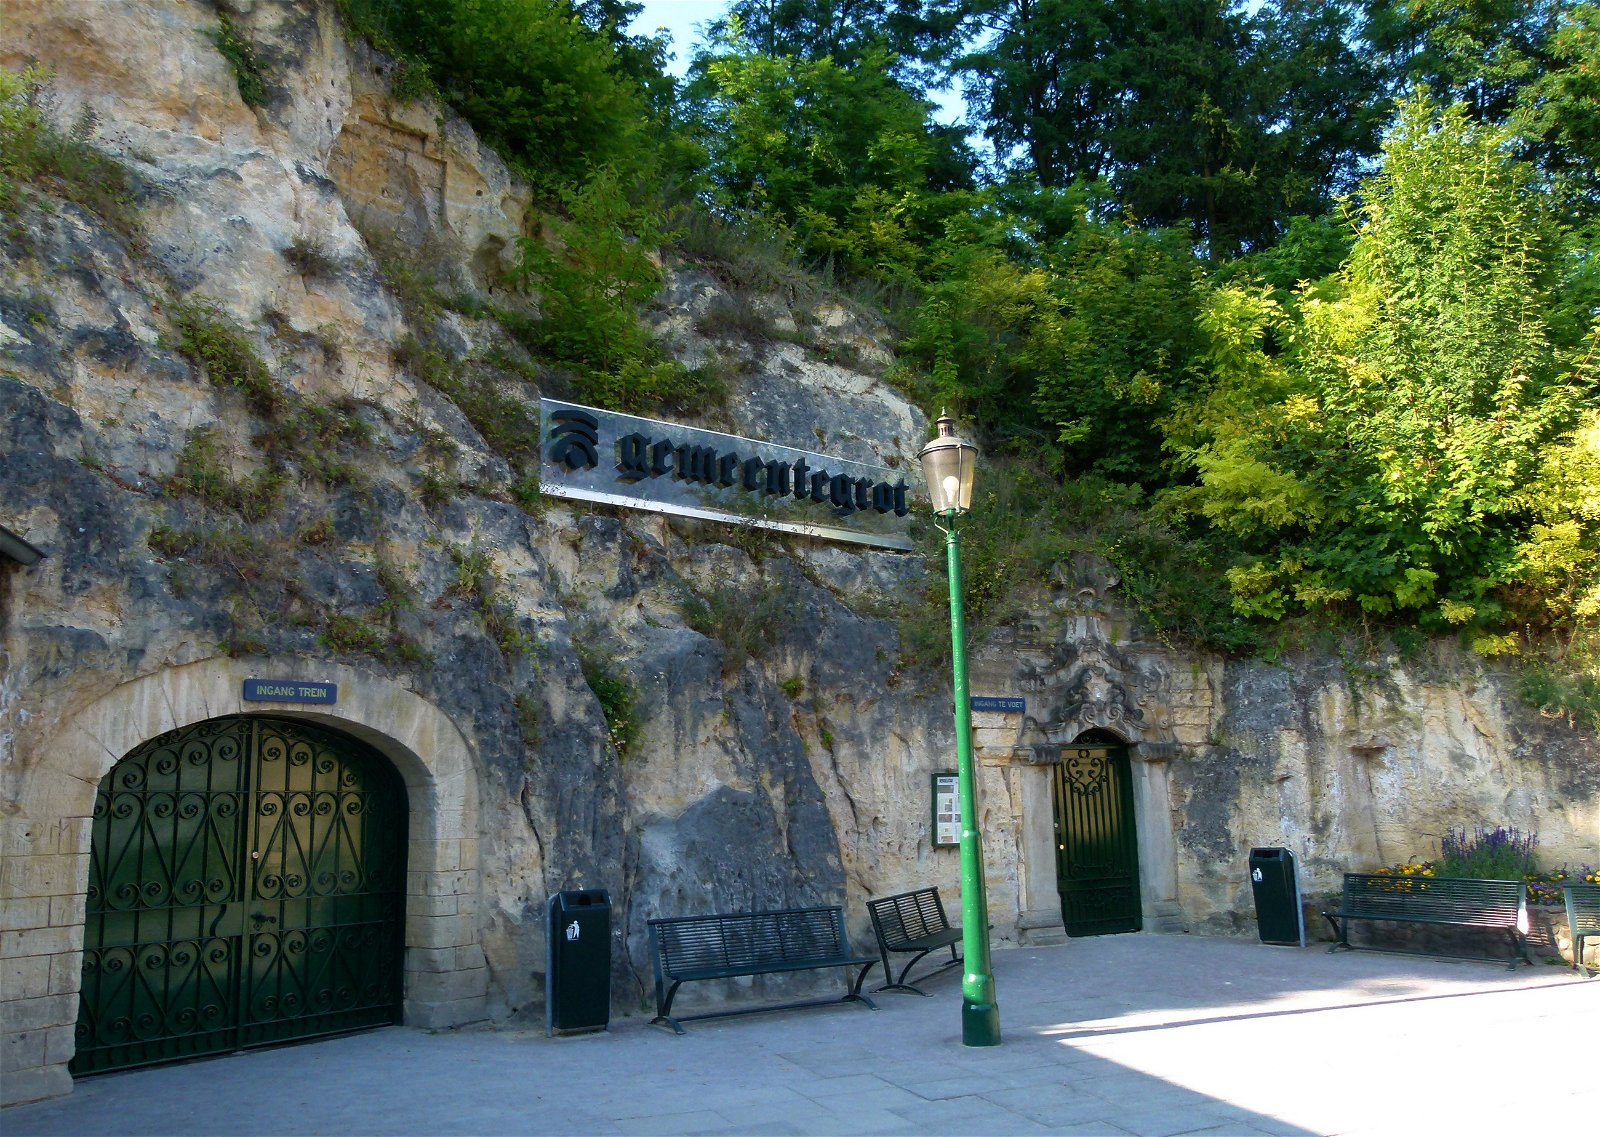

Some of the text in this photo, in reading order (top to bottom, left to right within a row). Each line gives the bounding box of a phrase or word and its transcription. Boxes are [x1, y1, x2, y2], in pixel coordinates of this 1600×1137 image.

[614, 431, 910, 518] gemeentegrot
[256, 685, 327, 698] INGANG TREIN
[974, 700, 997, 708] INGANG
[998, 700, 1006, 708] TE
